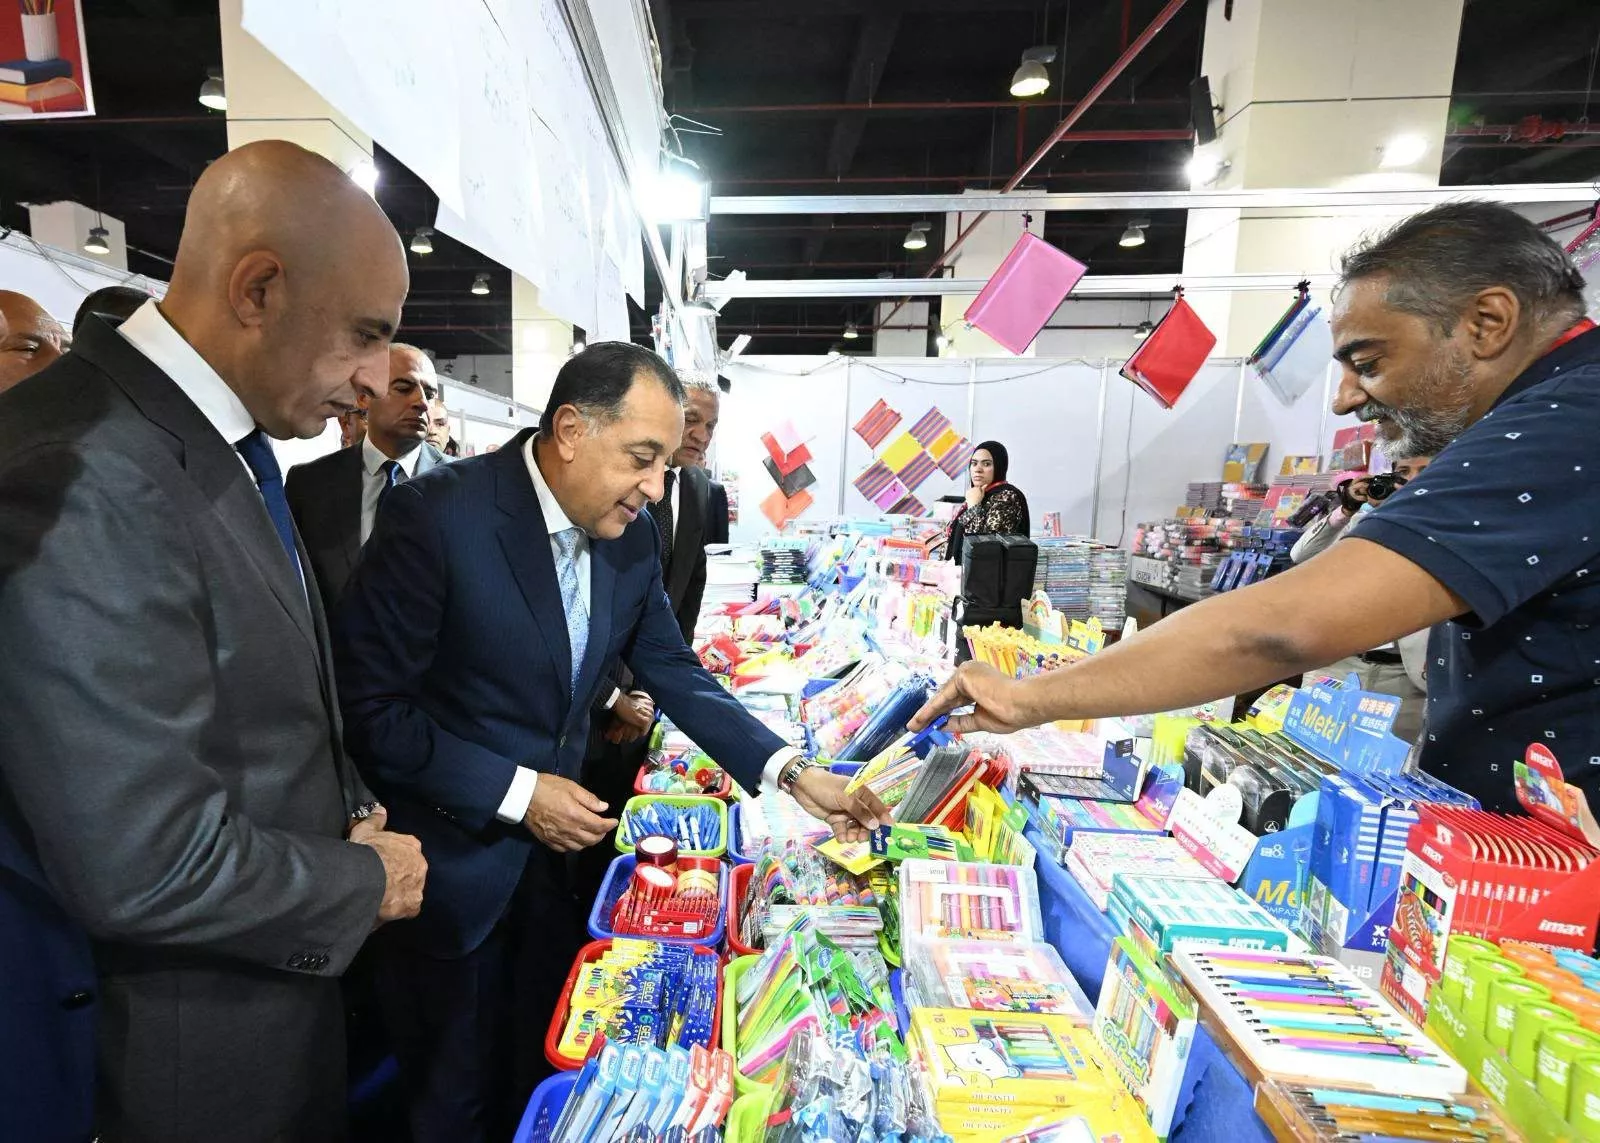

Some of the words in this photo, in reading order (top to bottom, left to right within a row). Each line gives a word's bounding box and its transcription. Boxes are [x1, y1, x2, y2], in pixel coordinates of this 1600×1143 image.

[1301, 703, 1347, 745] Metal
[1530, 750, 1554, 769] imax
[1421, 843, 1445, 865] imax
[1538, 919, 1587, 937] imax
[1350, 964, 1373, 979] HB
[644, 981, 655, 1004] GELCY
